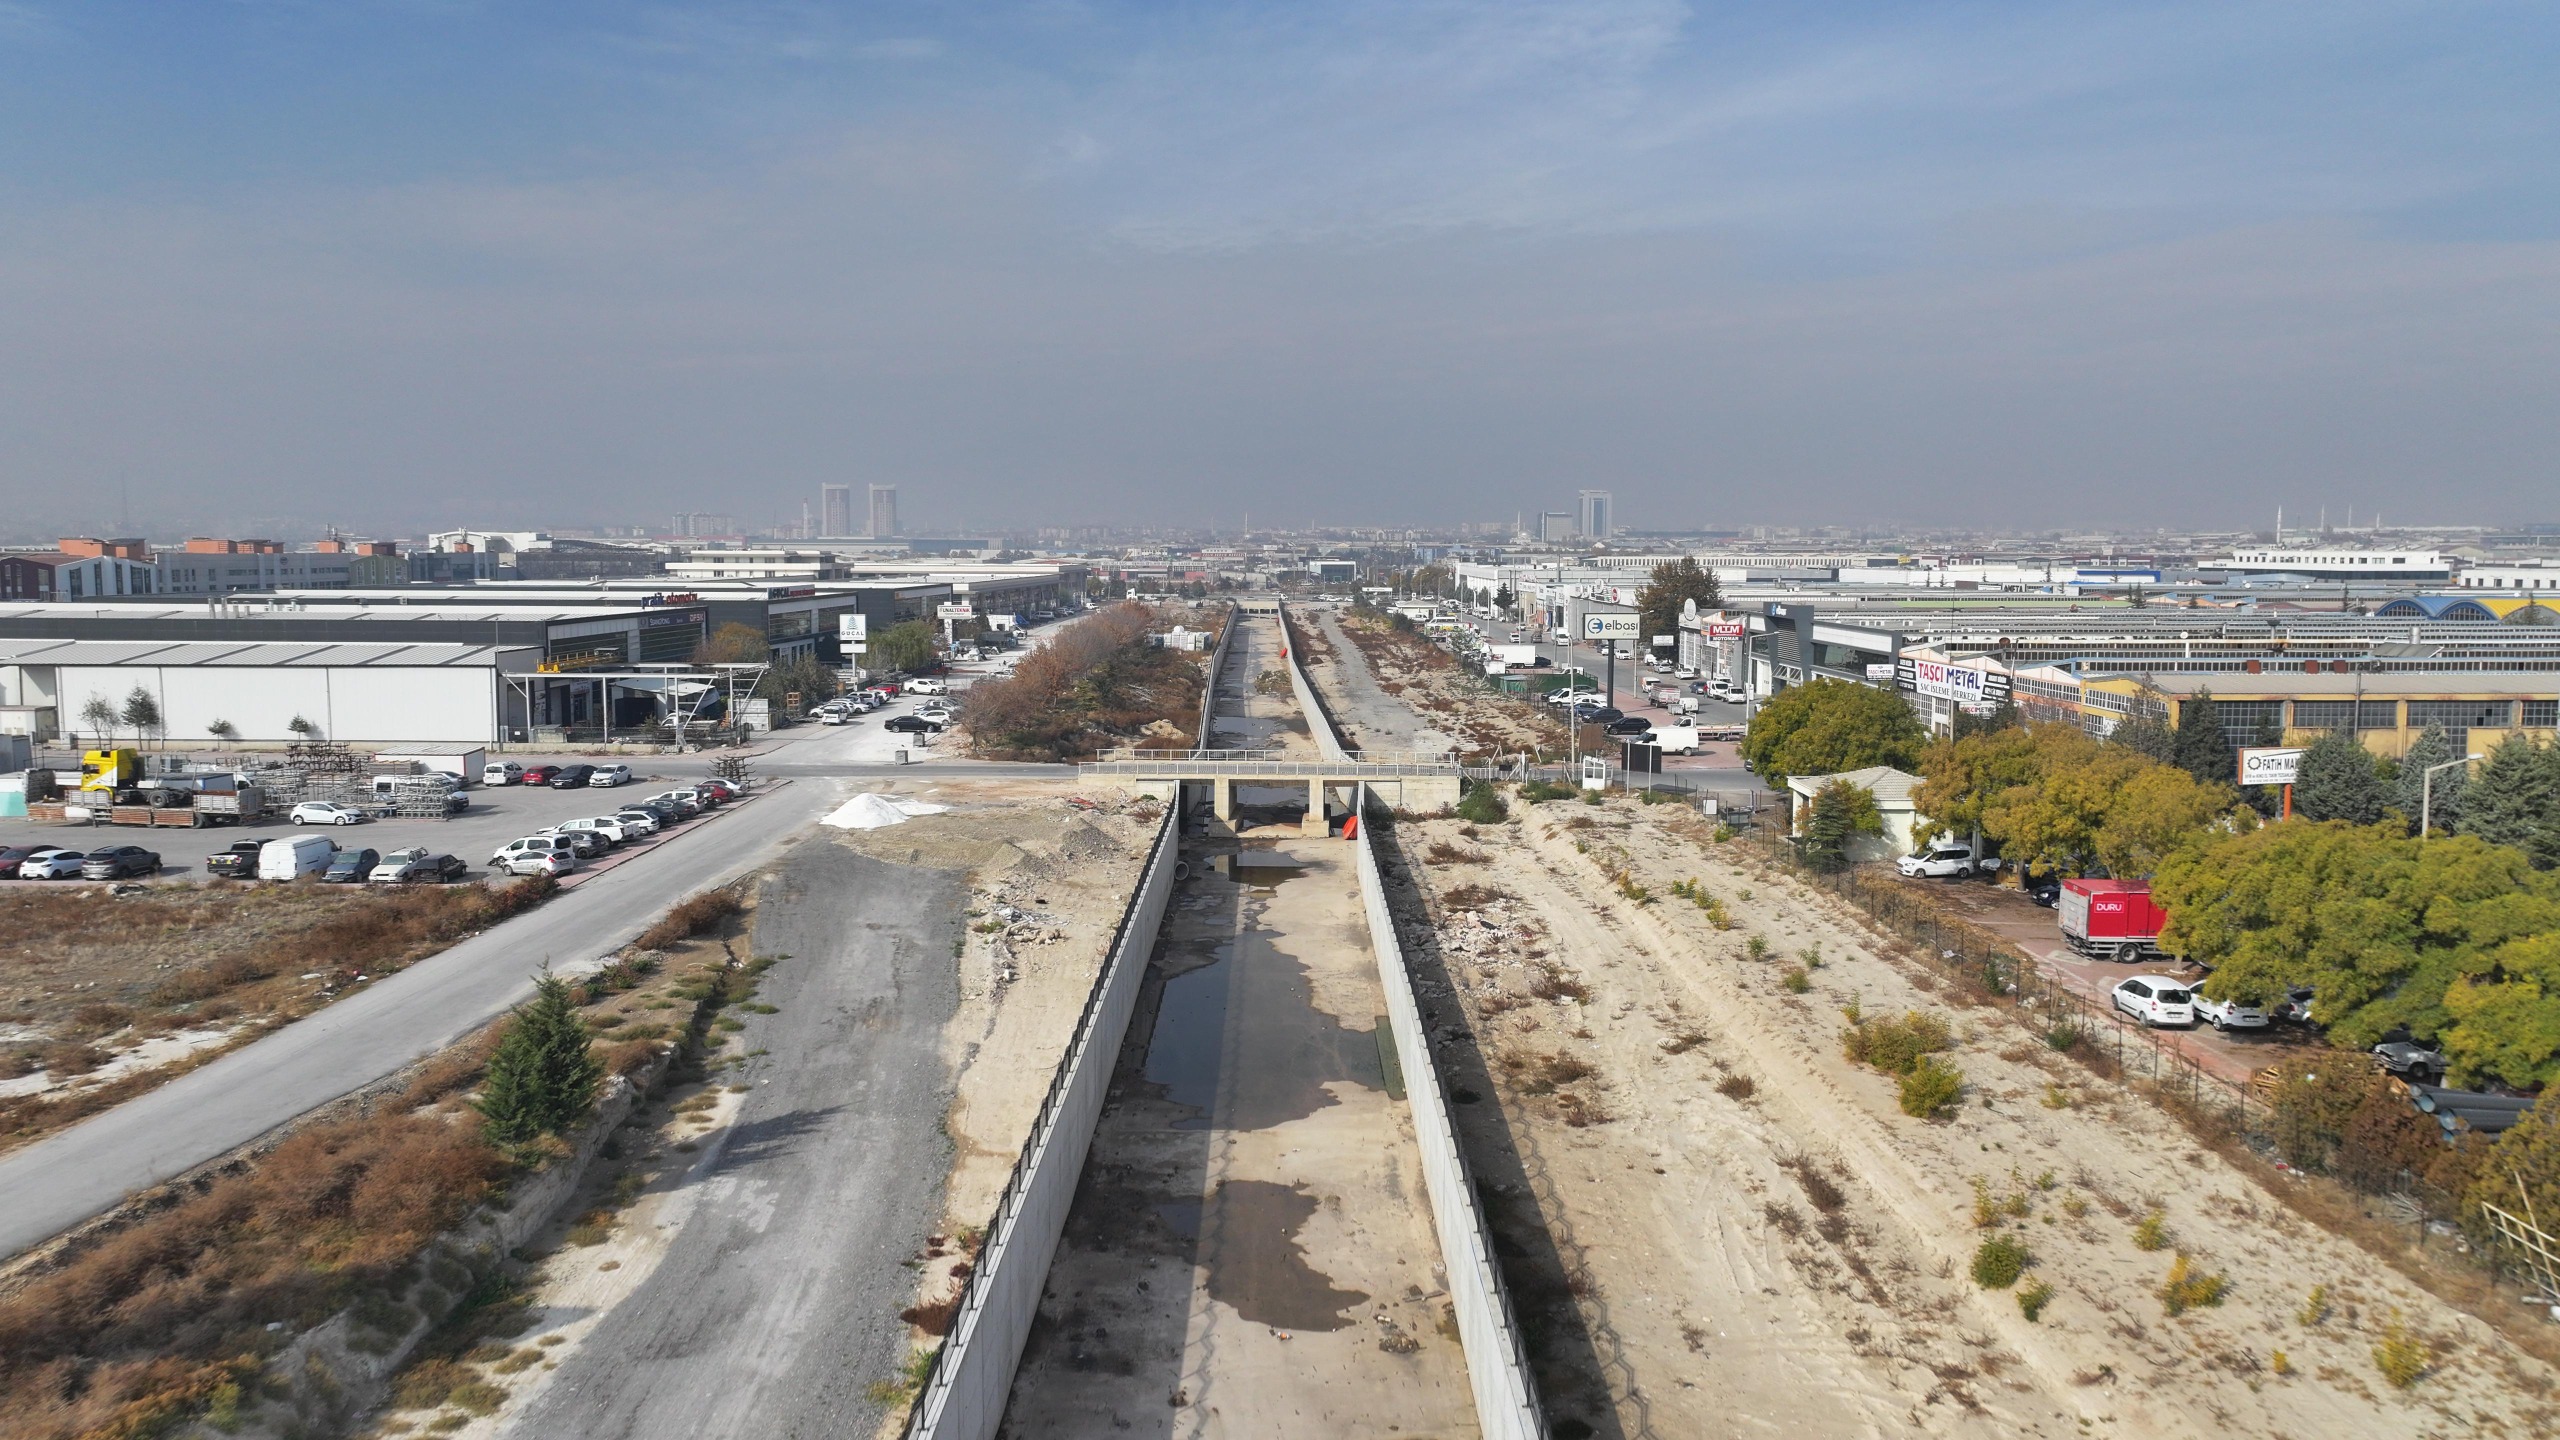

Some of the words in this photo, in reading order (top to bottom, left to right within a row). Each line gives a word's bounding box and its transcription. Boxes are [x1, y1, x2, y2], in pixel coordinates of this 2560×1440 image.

[1713, 625, 1740, 634] MTM
[1946, 668, 1981, 690] METAL
[2096, 903, 2122, 911] DURU
